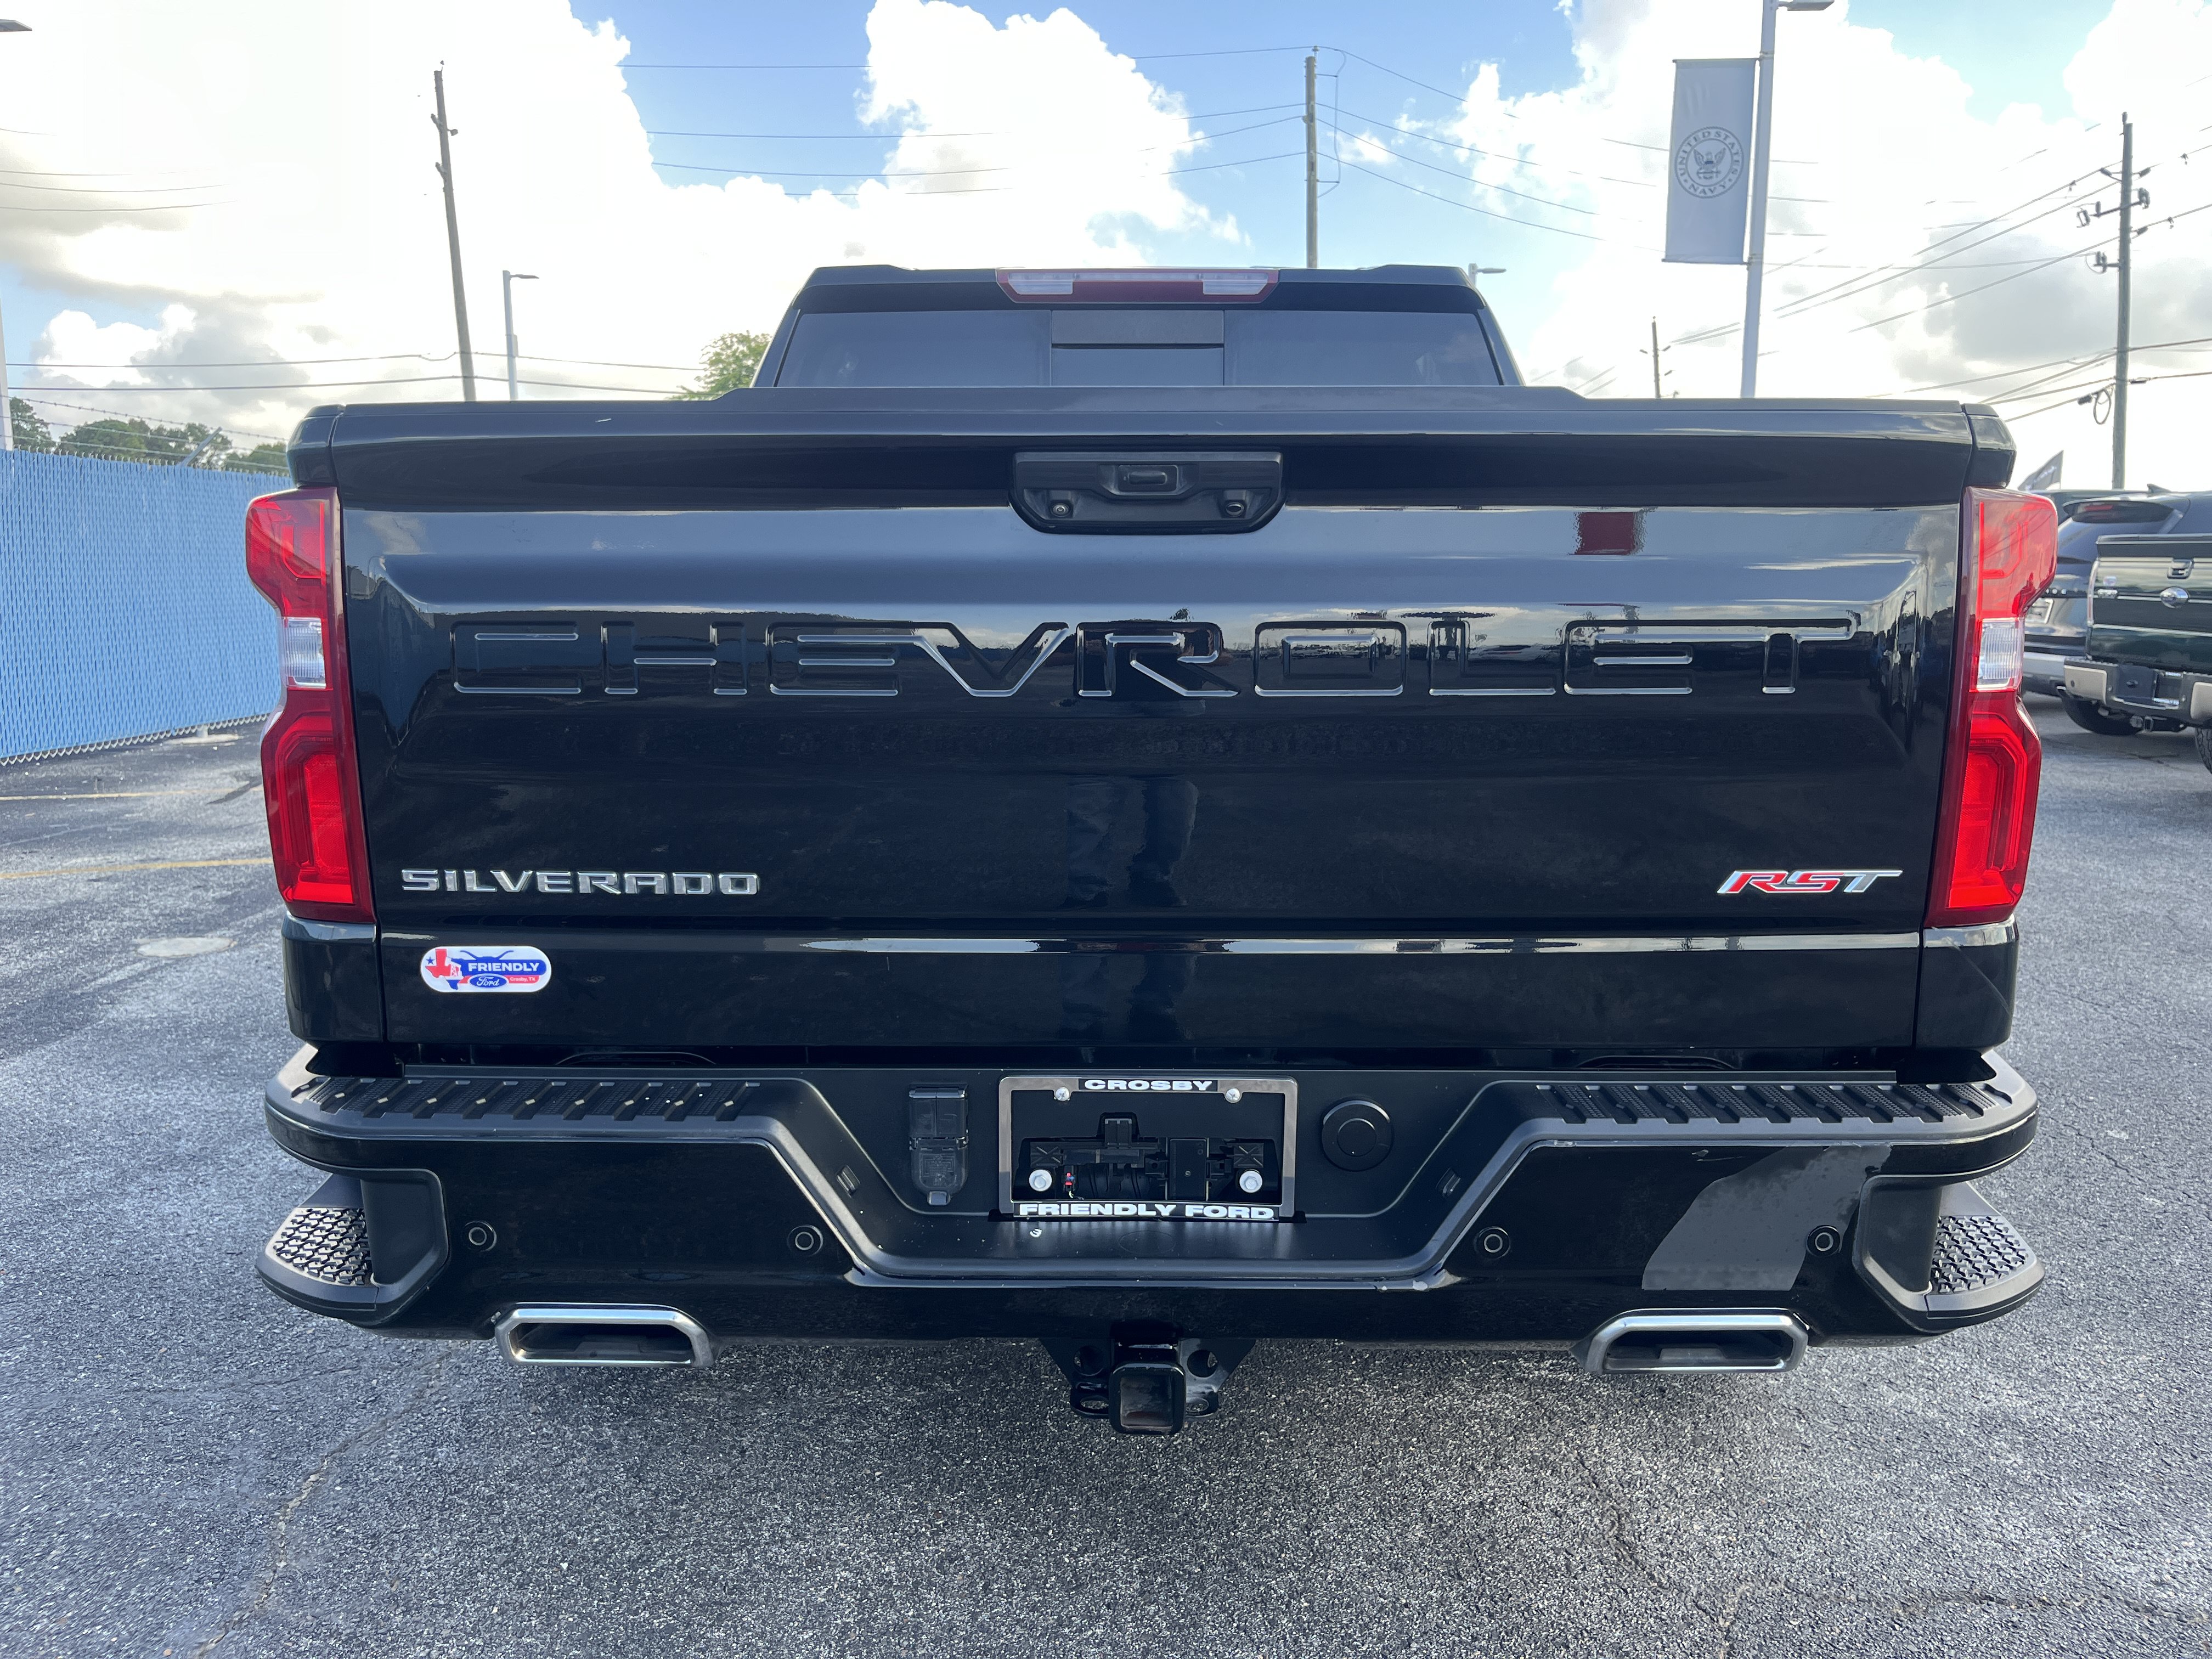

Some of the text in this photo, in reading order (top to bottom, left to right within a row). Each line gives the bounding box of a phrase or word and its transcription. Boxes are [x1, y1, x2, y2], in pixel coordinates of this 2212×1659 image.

[1679, 131, 1740, 176] UNITED STATES
[1689, 182, 1726, 195] NAVY
[450, 617, 1858, 696] CHEVROLET
[402, 869, 759, 895] SILVERADO
[1717, 870, 1903, 894] RST
[469, 963, 539, 972] FRIENDLY
[477, 976, 500, 986] Ford
[1084, 1079, 1212, 1091] CROSBY
[1019, 1203, 1274, 1220] FRIENDLY FORD
